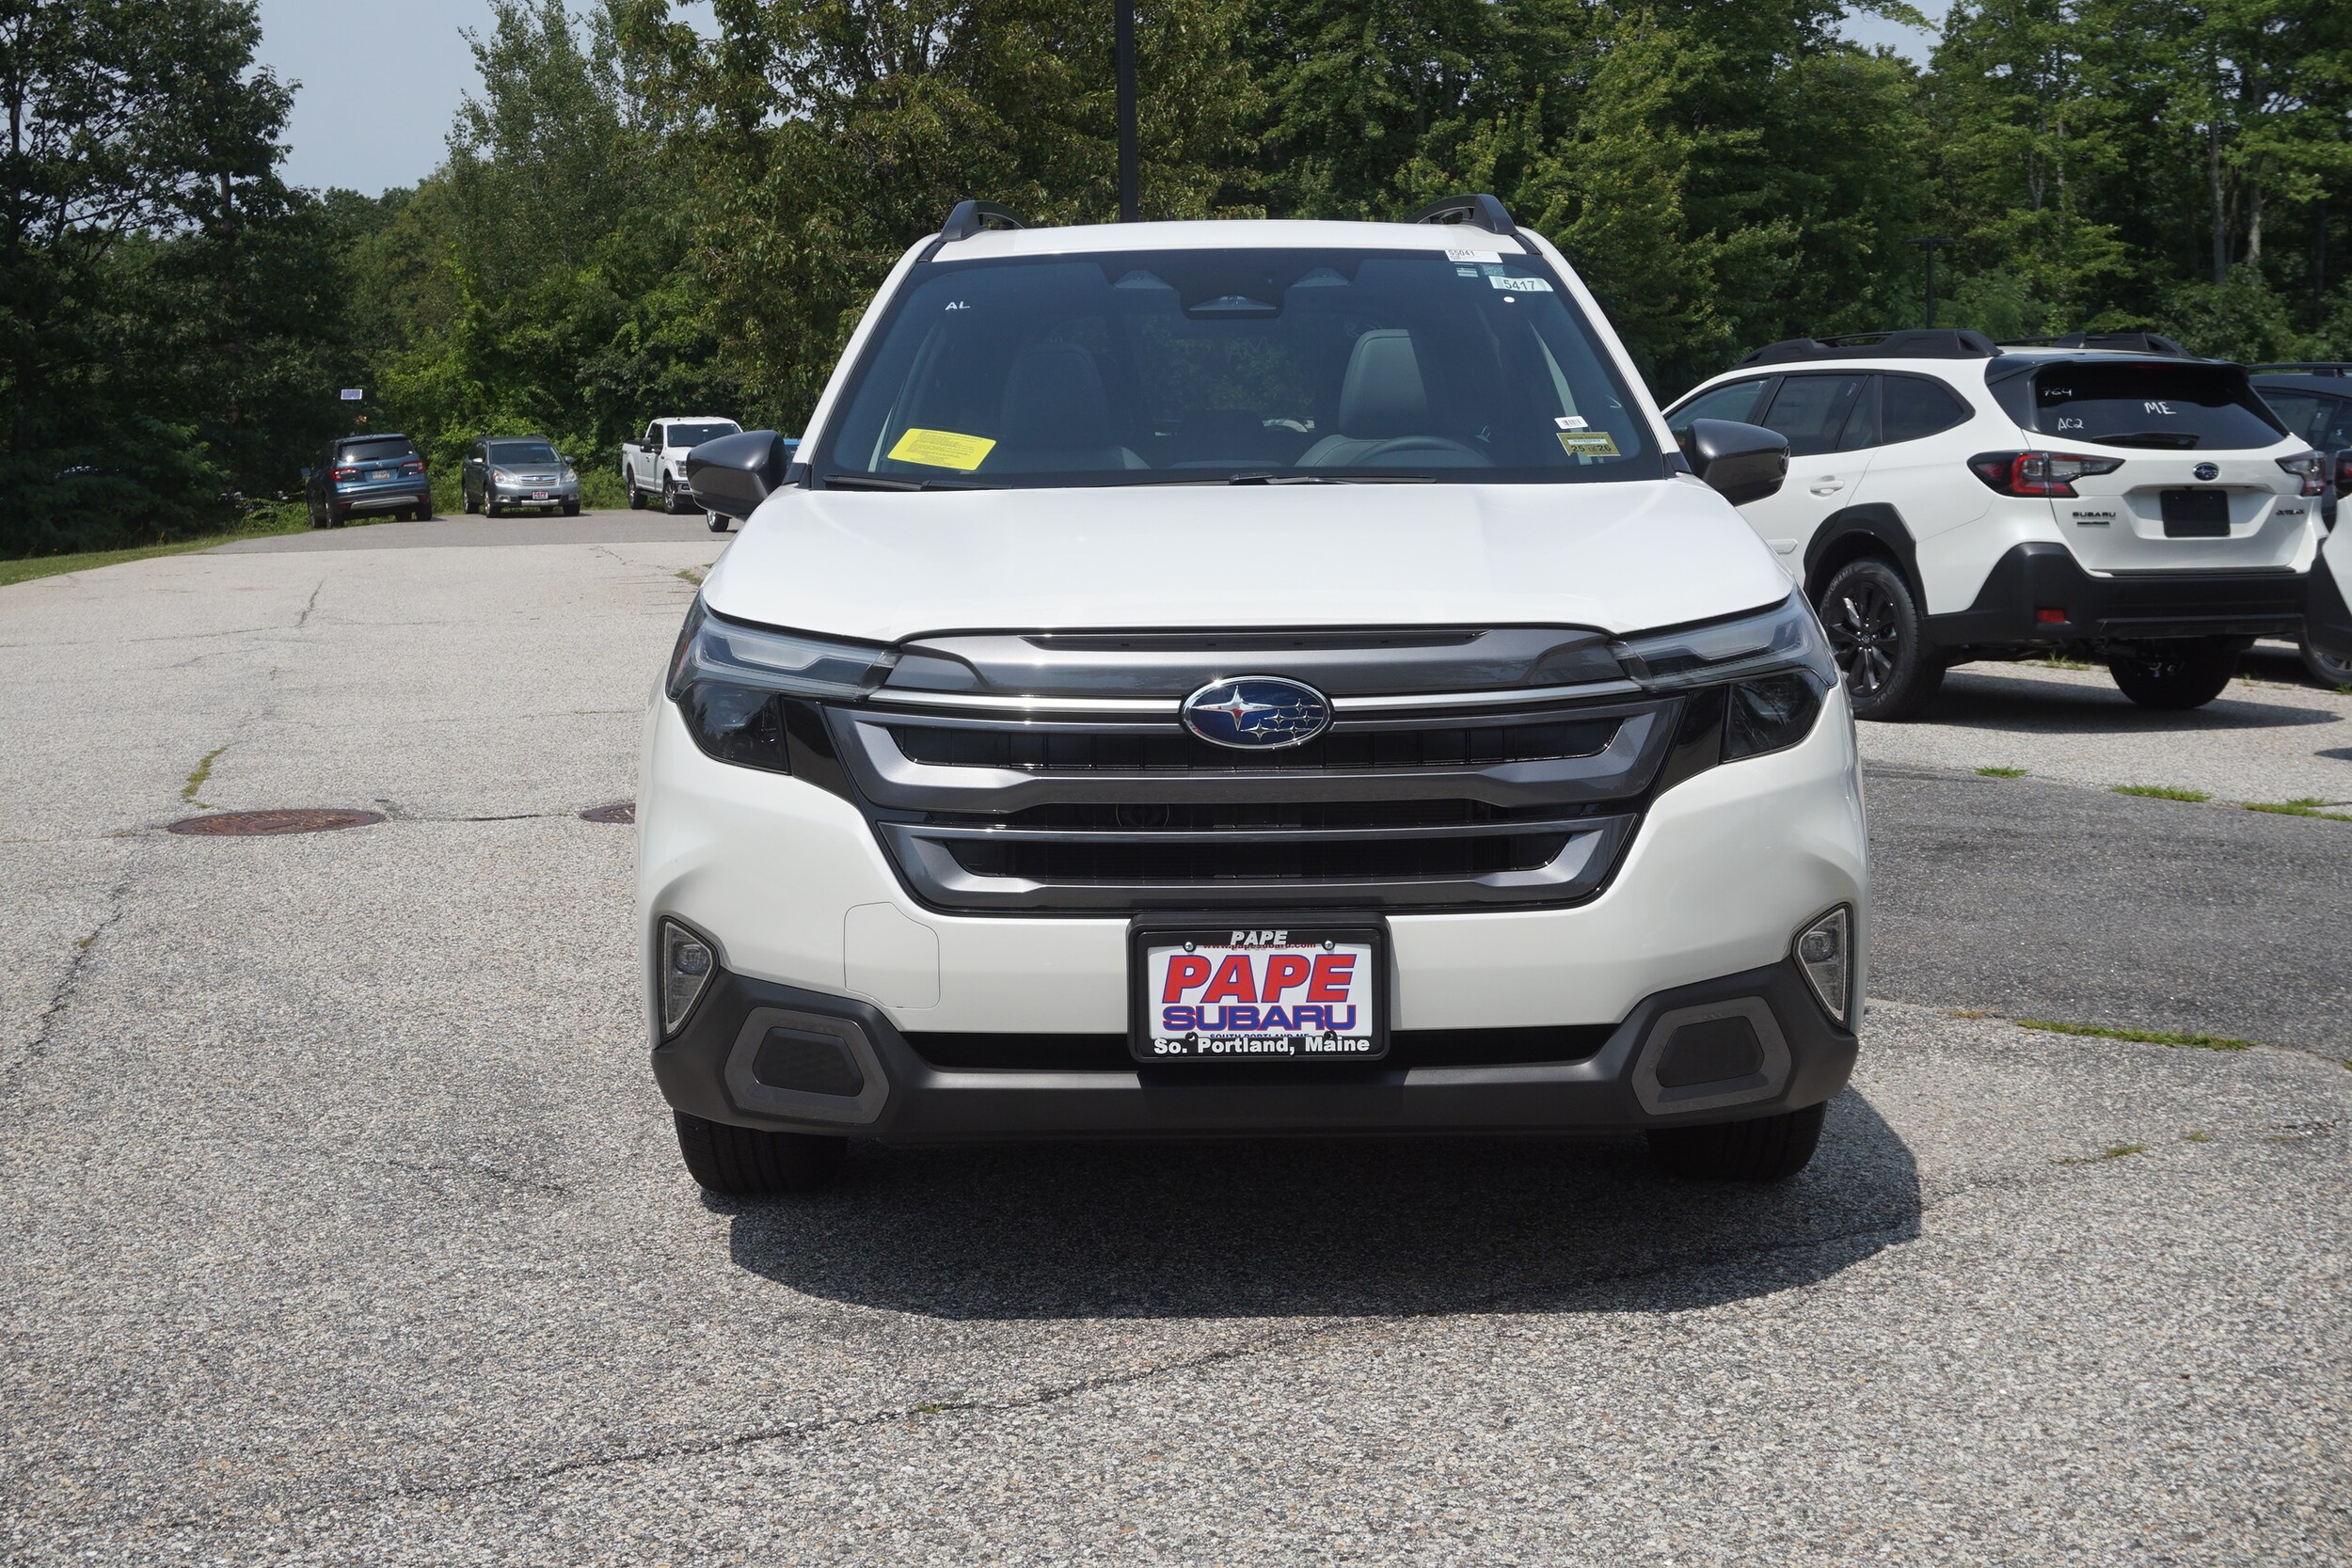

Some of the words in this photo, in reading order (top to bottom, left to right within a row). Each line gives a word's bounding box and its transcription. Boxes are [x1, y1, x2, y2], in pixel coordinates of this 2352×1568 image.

[1502, 279, 1535, 291] 5417
[945, 301, 970, 310] AL
[2143, 401, 2177, 415] ME
[2058, 418, 2084, 431] AC2
[1231, 930, 1288, 945] PAPE
[1162, 954, 1358, 1004] PAPE
[1162, 1005, 1357, 1031] SUBARU
[1153, 1037, 1187, 1053] So.
[1198, 1037, 1295, 1055] Portland,
[1305, 1036, 1370, 1052] Maine
